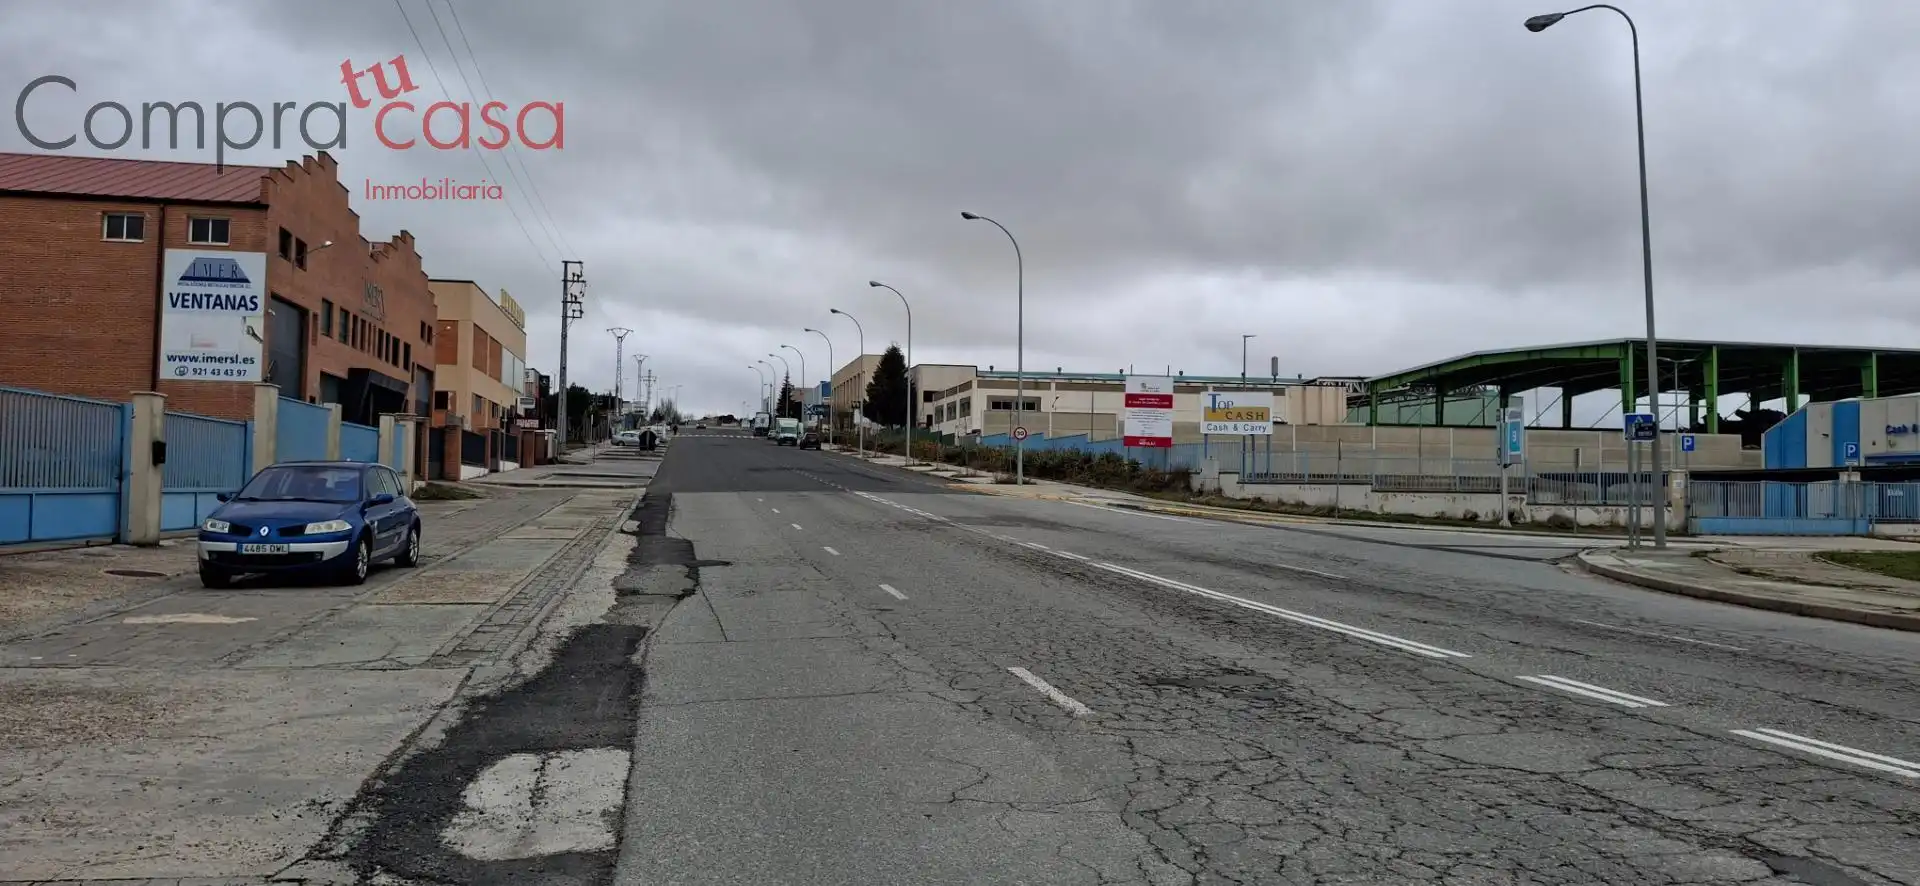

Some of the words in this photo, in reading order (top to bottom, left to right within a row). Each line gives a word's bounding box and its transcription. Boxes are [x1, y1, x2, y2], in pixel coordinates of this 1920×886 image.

[168, 292, 259, 312] VENTANAS
[166, 352, 256, 365] www.imersl.es
[192, 367, 208, 376] 921
[210, 368, 221, 376] 43
[223, 368, 234, 376] 43
[236, 369, 247, 377] 97
[1225, 411, 1265, 421] CASH
[1206, 423, 1229, 431] Cash
[1232, 423, 1239, 431] &
[1243, 423, 1267, 432] Carry
[1683, 437, 1693, 450] P
[1847, 444, 1857, 457] P
